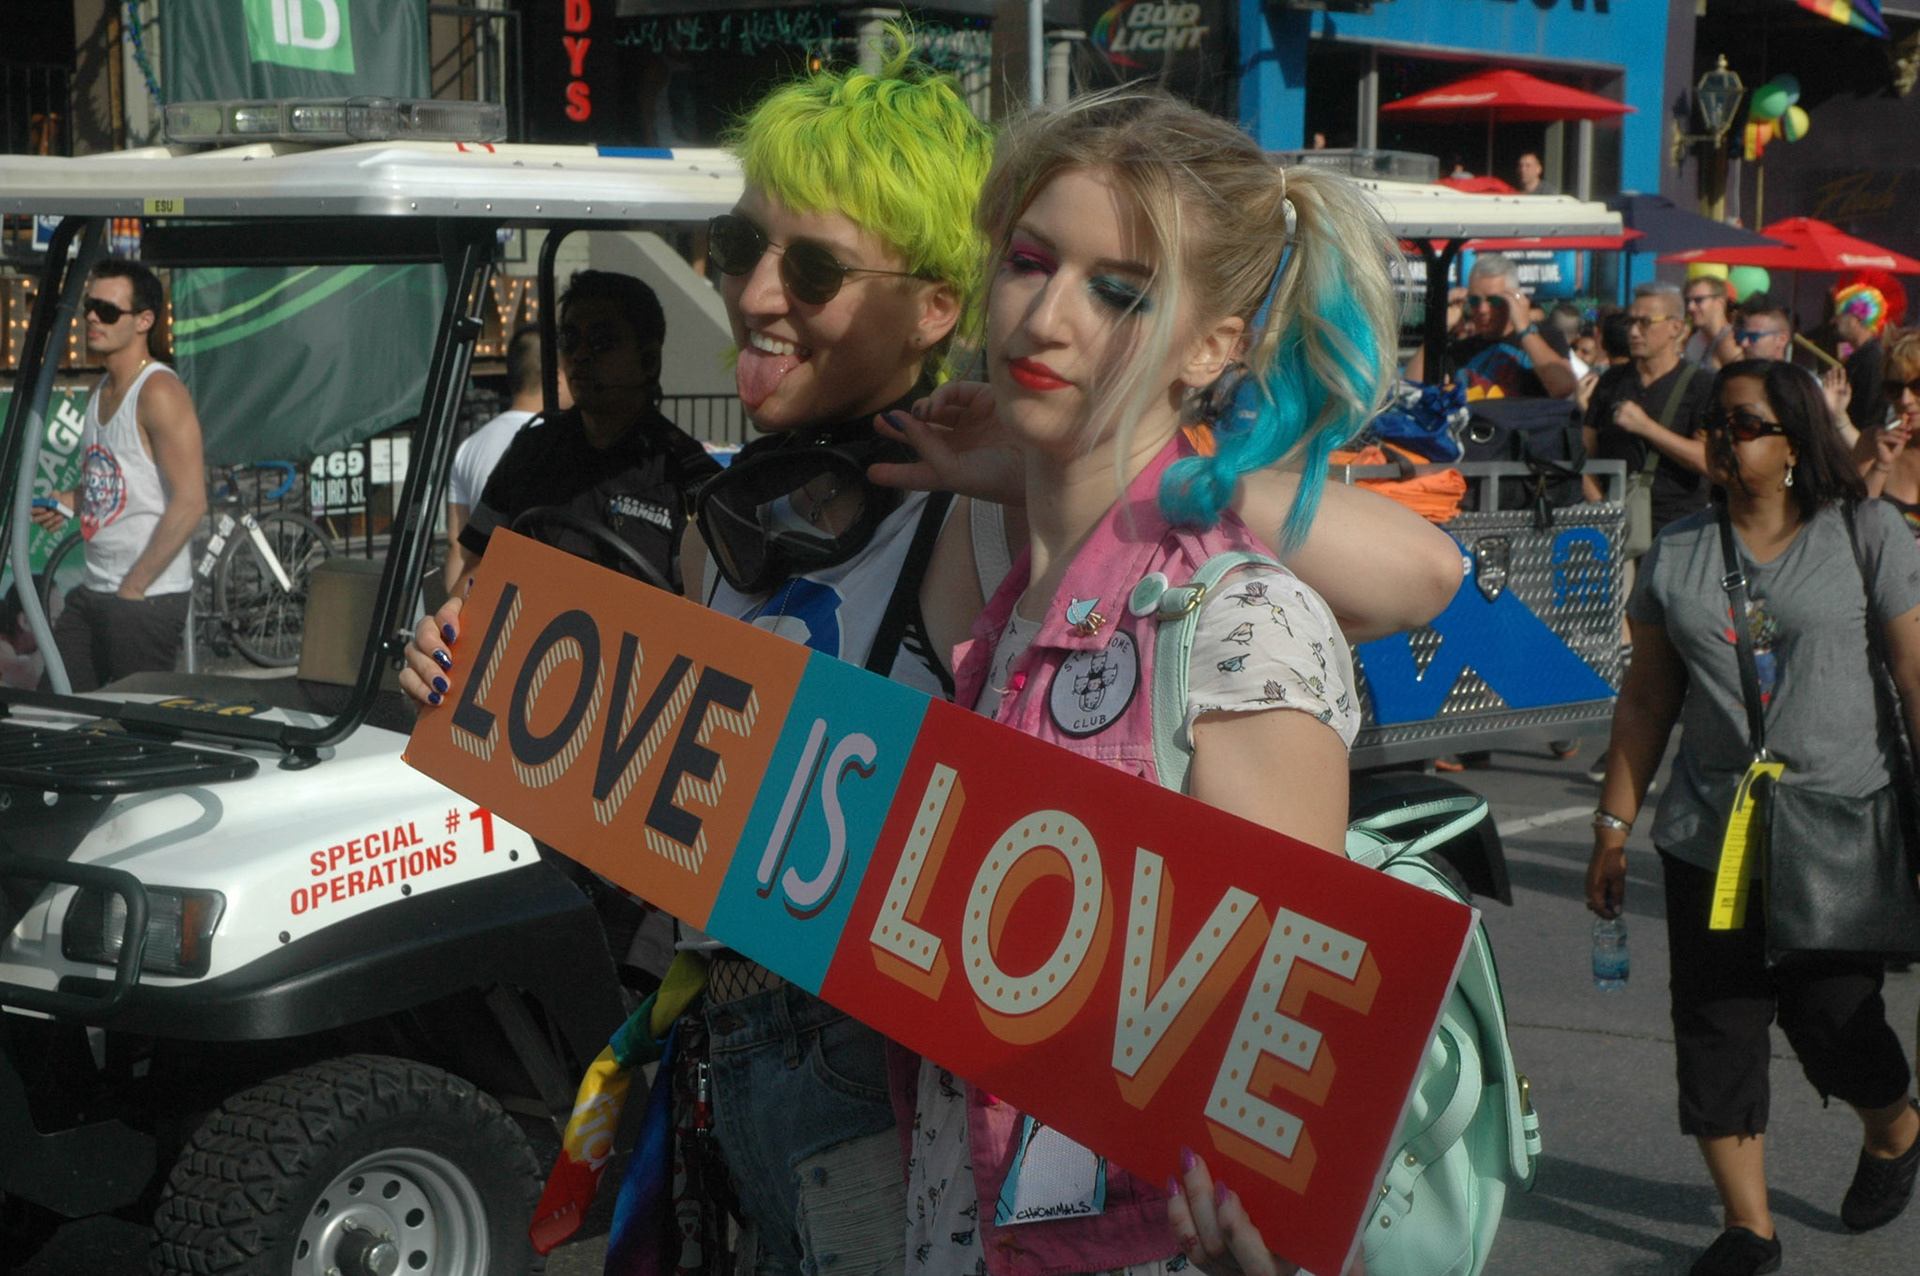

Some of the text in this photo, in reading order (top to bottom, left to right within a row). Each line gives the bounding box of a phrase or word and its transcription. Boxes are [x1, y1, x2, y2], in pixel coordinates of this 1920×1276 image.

[1126, 2, 1201, 27] BUD
[1110, 25, 1211, 51] LIGHT
[154, 200, 173, 213] ESU
[310, 450, 365, 479] 469
[1072, 714, 1107, 730] CLUB
[309, 821, 424, 877] SPECIAL
[290, 840, 458, 916] OPERATIONS
[451, 582, 1381, 1195] LOVE IS LOVE
